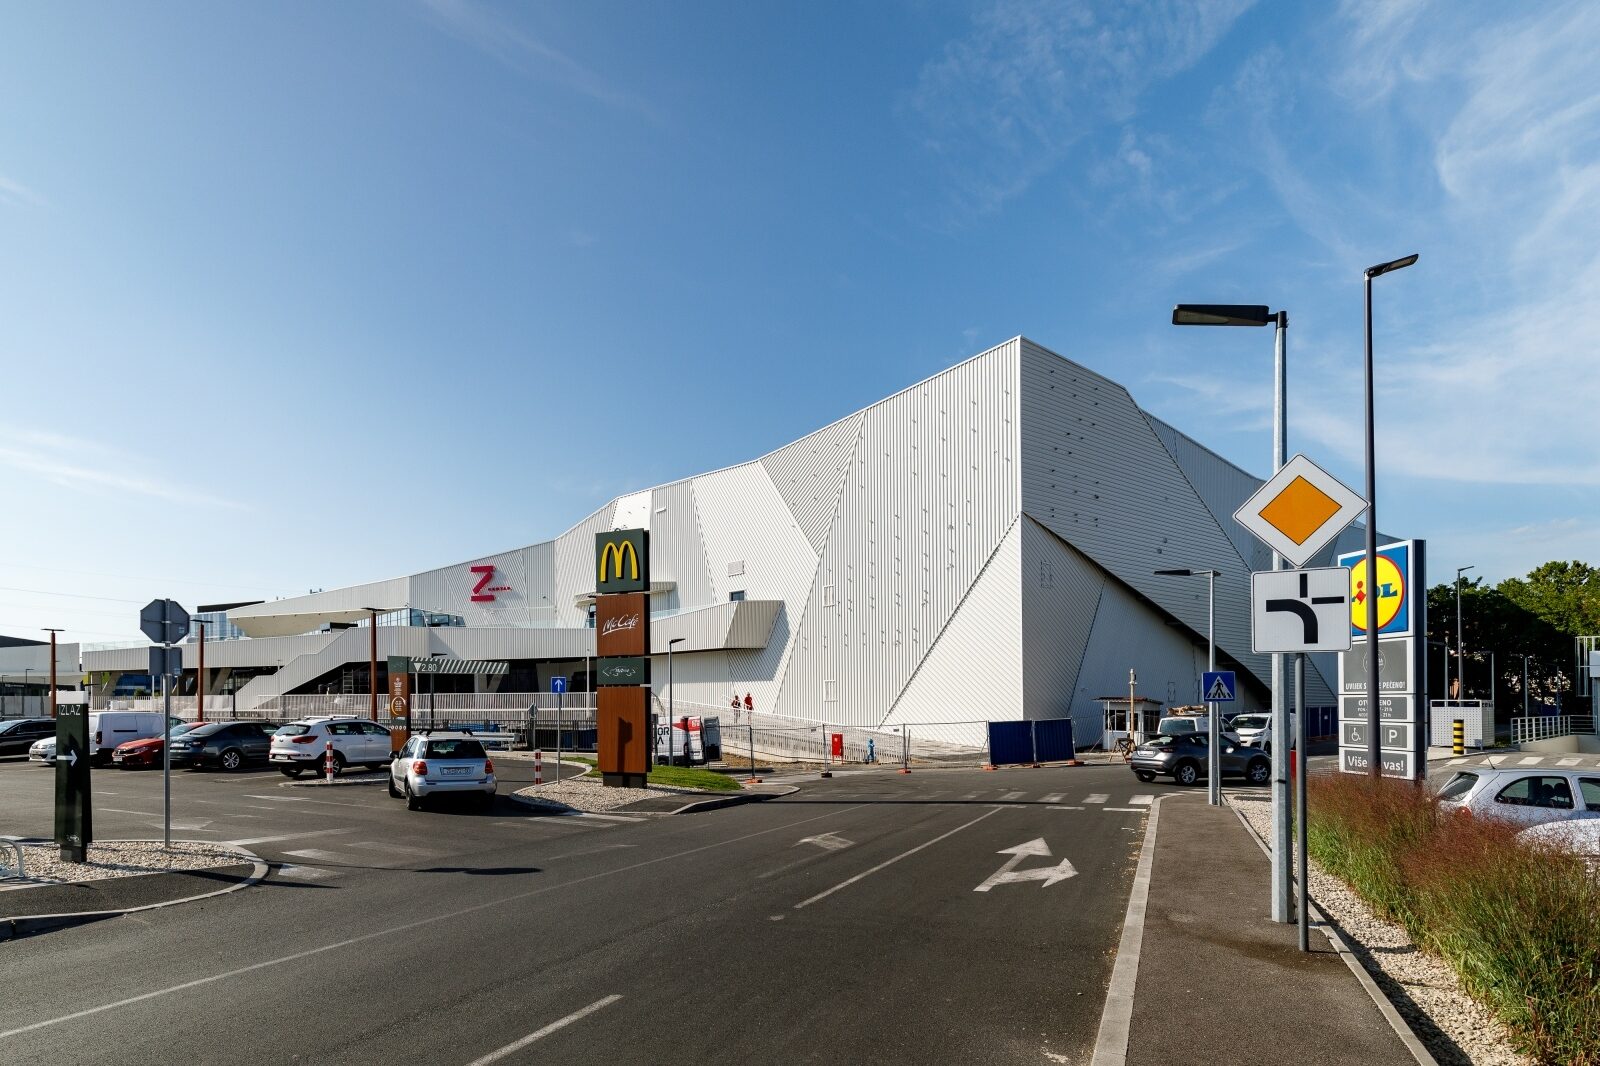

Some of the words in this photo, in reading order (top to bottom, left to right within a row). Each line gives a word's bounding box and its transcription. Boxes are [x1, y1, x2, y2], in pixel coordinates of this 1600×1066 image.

[421, 663, 437, 672] 2.80
[1345, 682, 1363, 690] UVIJEK
[58, 704, 81, 716] IZLAZ
[1347, 755, 1368, 768] Više
[1383, 760, 1404, 771] vas!
